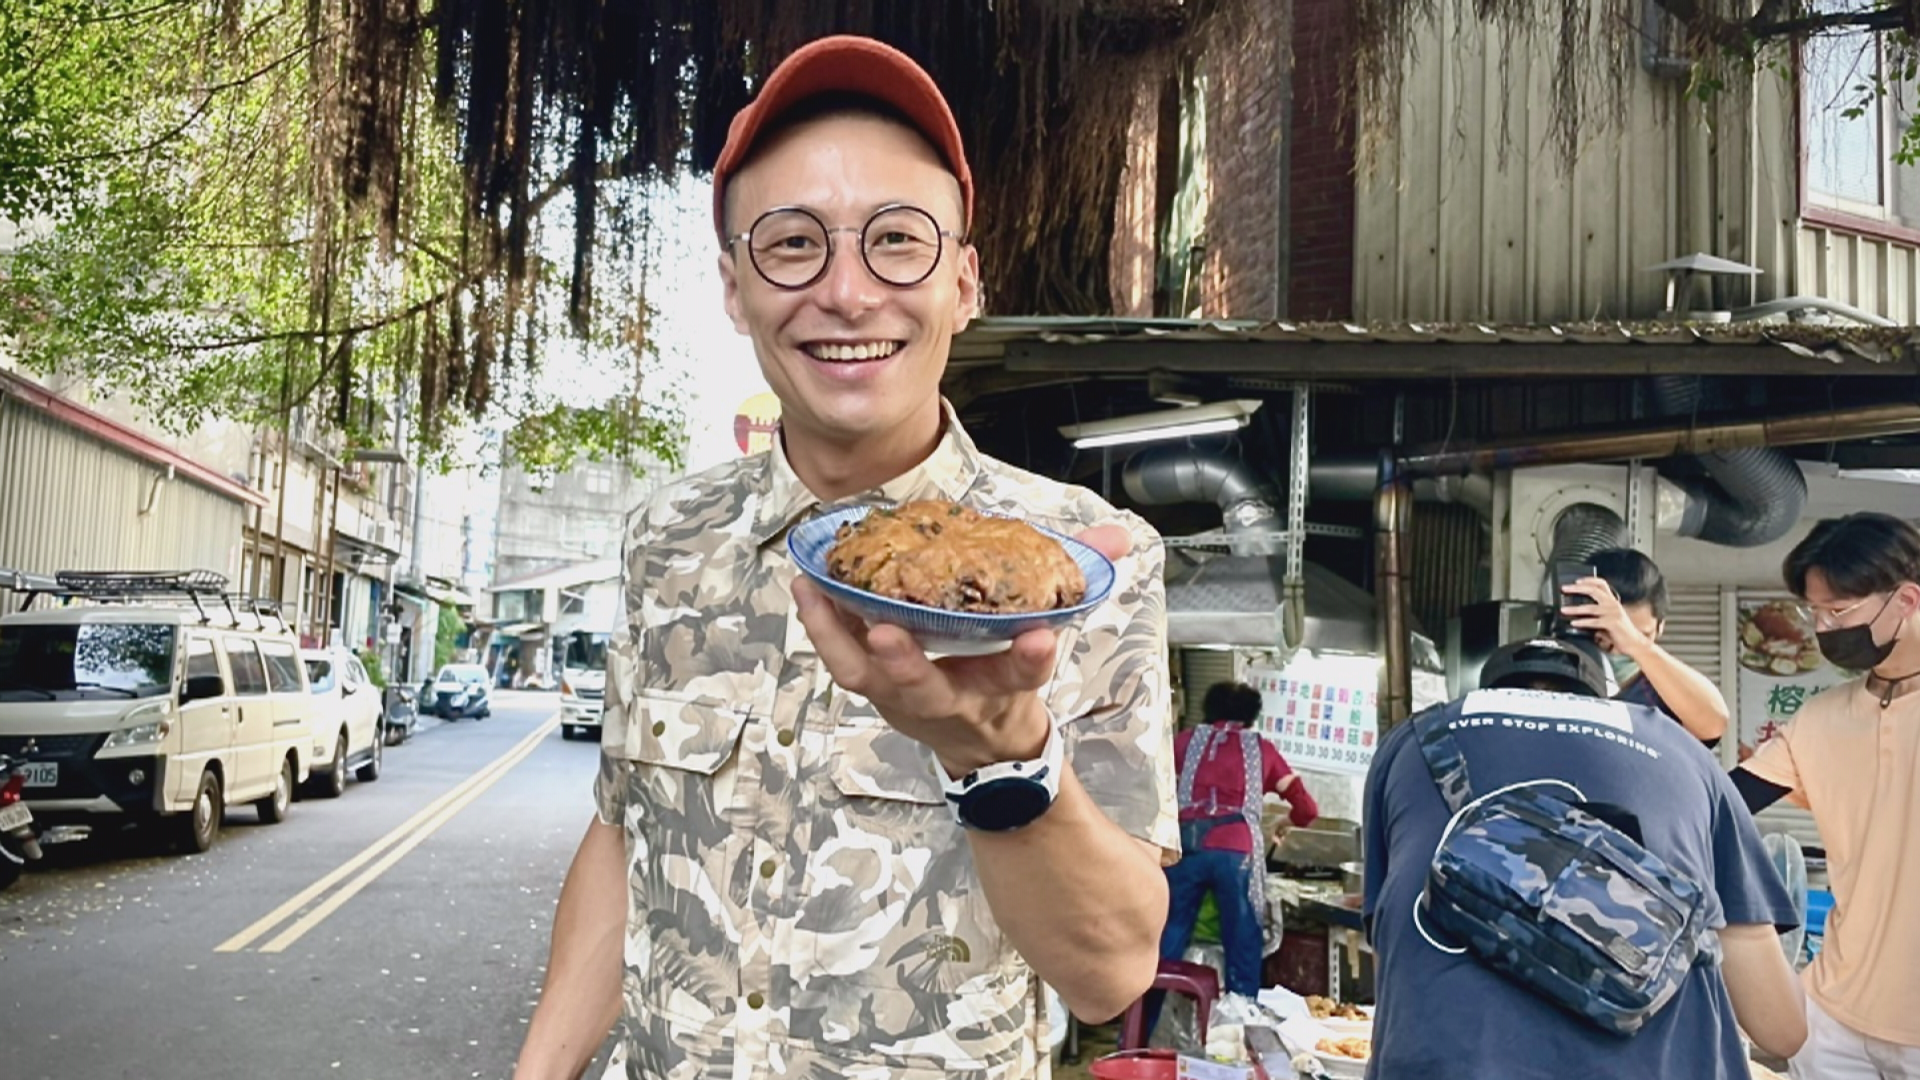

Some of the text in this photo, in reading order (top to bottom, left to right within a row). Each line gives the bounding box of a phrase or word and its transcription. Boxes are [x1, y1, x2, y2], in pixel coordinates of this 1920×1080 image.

[1448, 717, 1659, 759] EVER STOP EXPLORING
[1317, 745, 1329, 759] 30
[1331, 748, 1343, 761] 30
[1345, 750, 1357, 764] 50
[1359, 752, 1371, 765] 50
